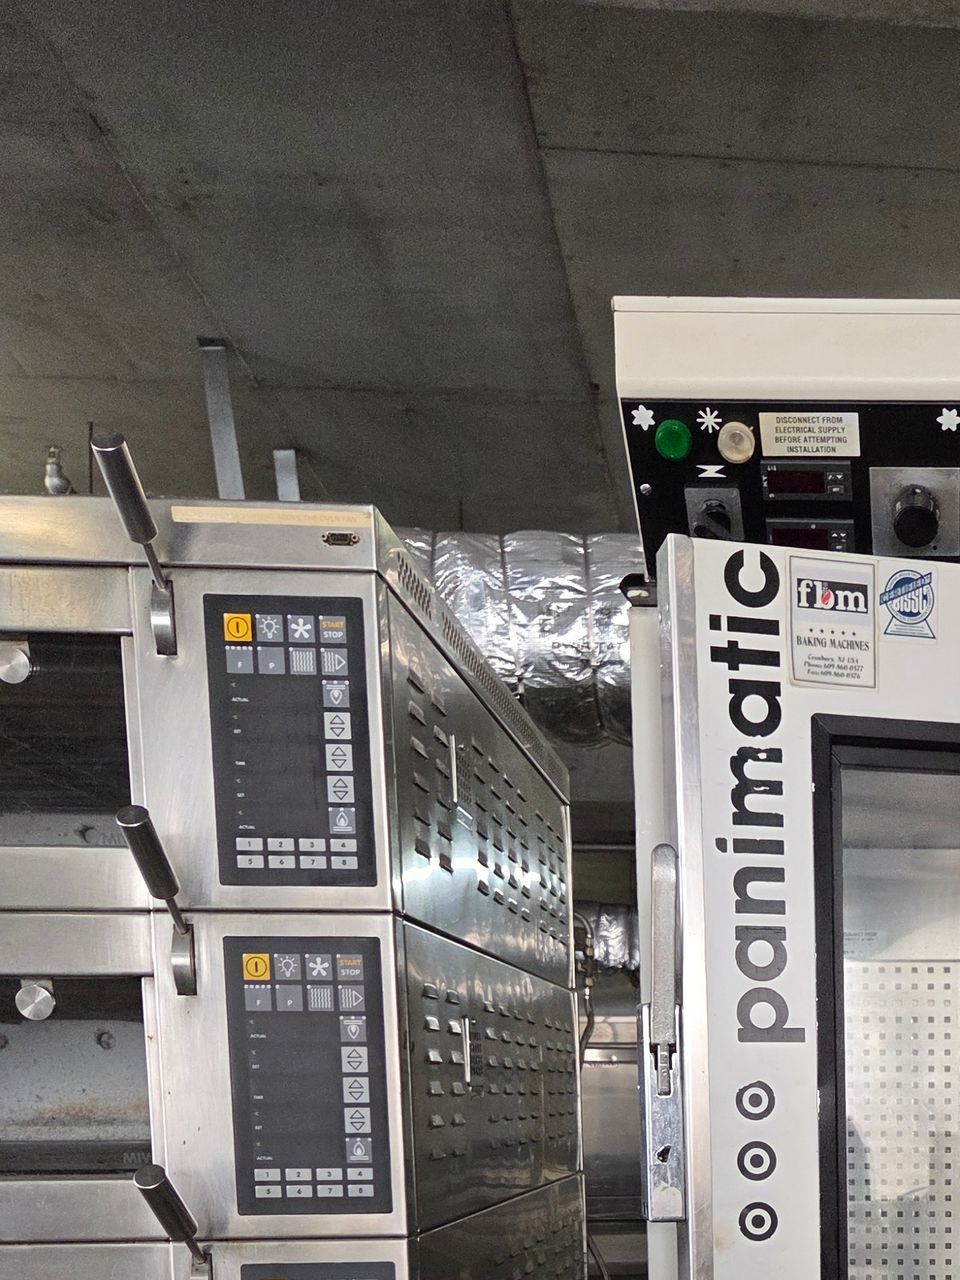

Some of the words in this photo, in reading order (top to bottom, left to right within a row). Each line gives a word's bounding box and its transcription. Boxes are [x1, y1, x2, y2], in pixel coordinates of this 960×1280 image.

[798, 580, 867, 613] fbm
[322, 621, 345, 629] START
[323, 631, 344, 639] STOP
[797, 635, 827, 648] BAKING
[829, 638, 870, 651] MACHINES
[709, 549, 807, 1046] panimatic
